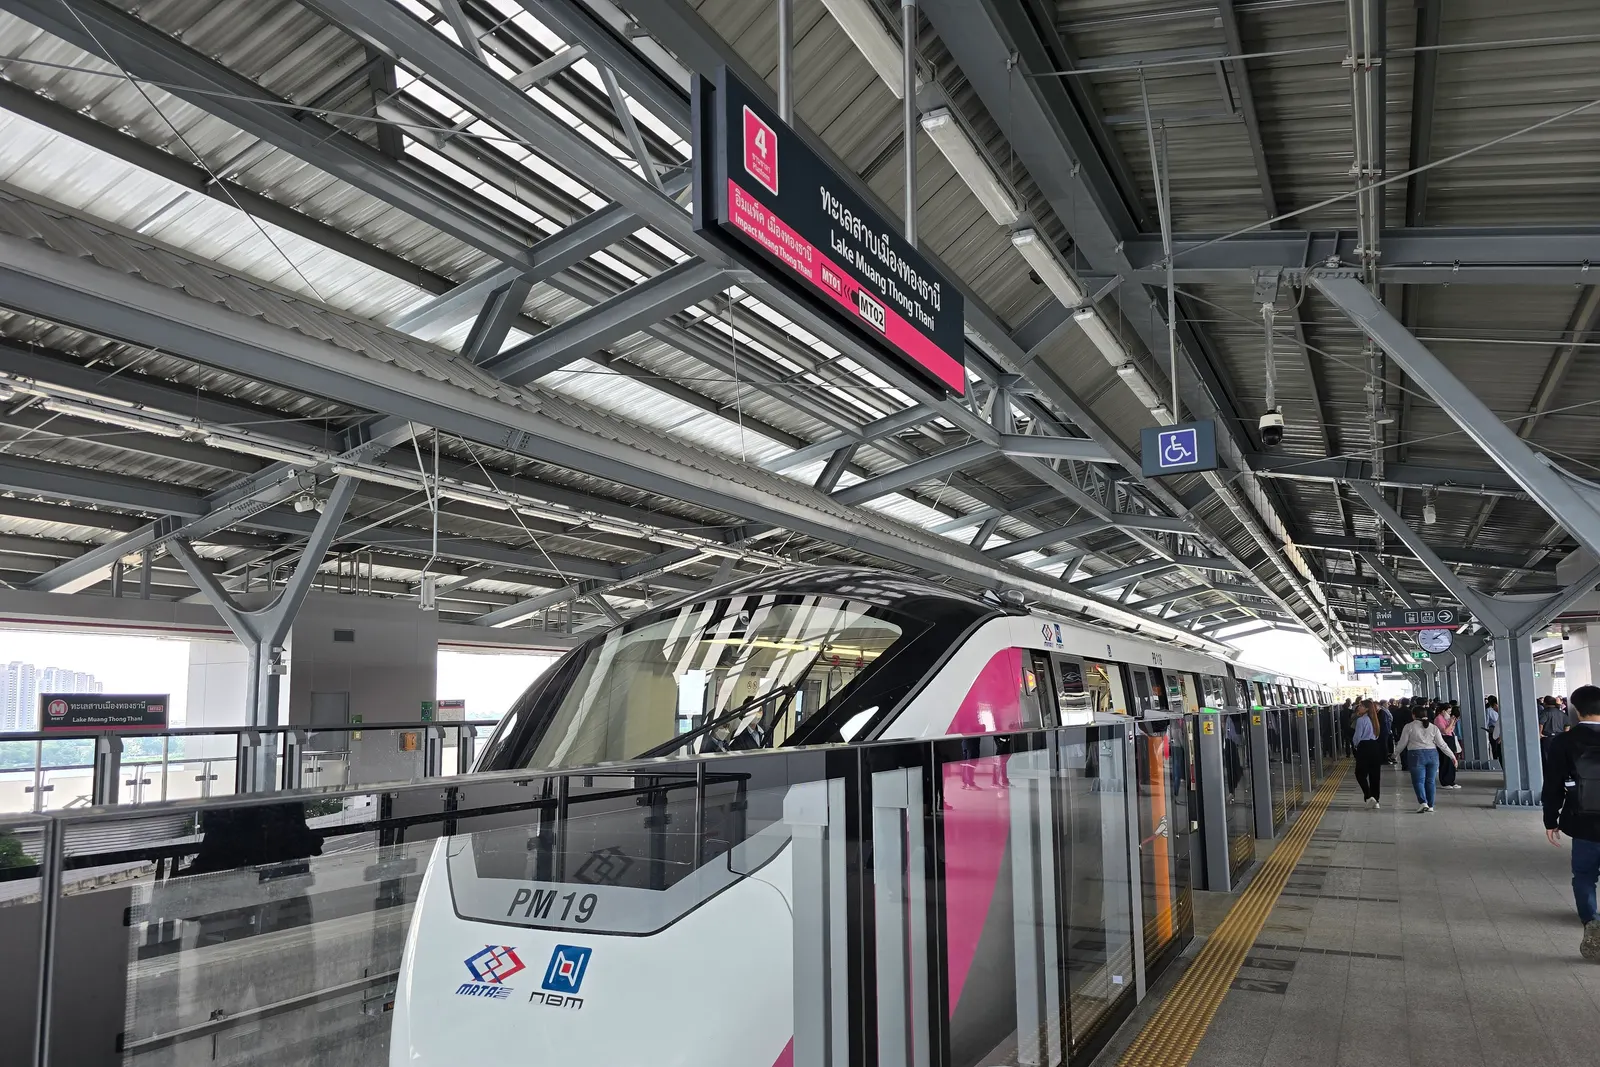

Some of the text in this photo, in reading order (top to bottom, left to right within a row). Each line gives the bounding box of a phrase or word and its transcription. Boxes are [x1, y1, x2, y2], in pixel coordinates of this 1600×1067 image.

[754, 127, 767, 159] 4
[735, 212, 813, 279] Impact Muang Thong Thani
[767, 215, 813, 263] เมืองทองธานี
[820, 186, 941, 312] ทะเลสาบเมืองทองธานี
[821, 267, 841, 292] MT01
[831, 229, 935, 332] Lake Muang Thong Thani
[860, 295, 884, 327] MT02
[88, 716, 108, 724] Muang
